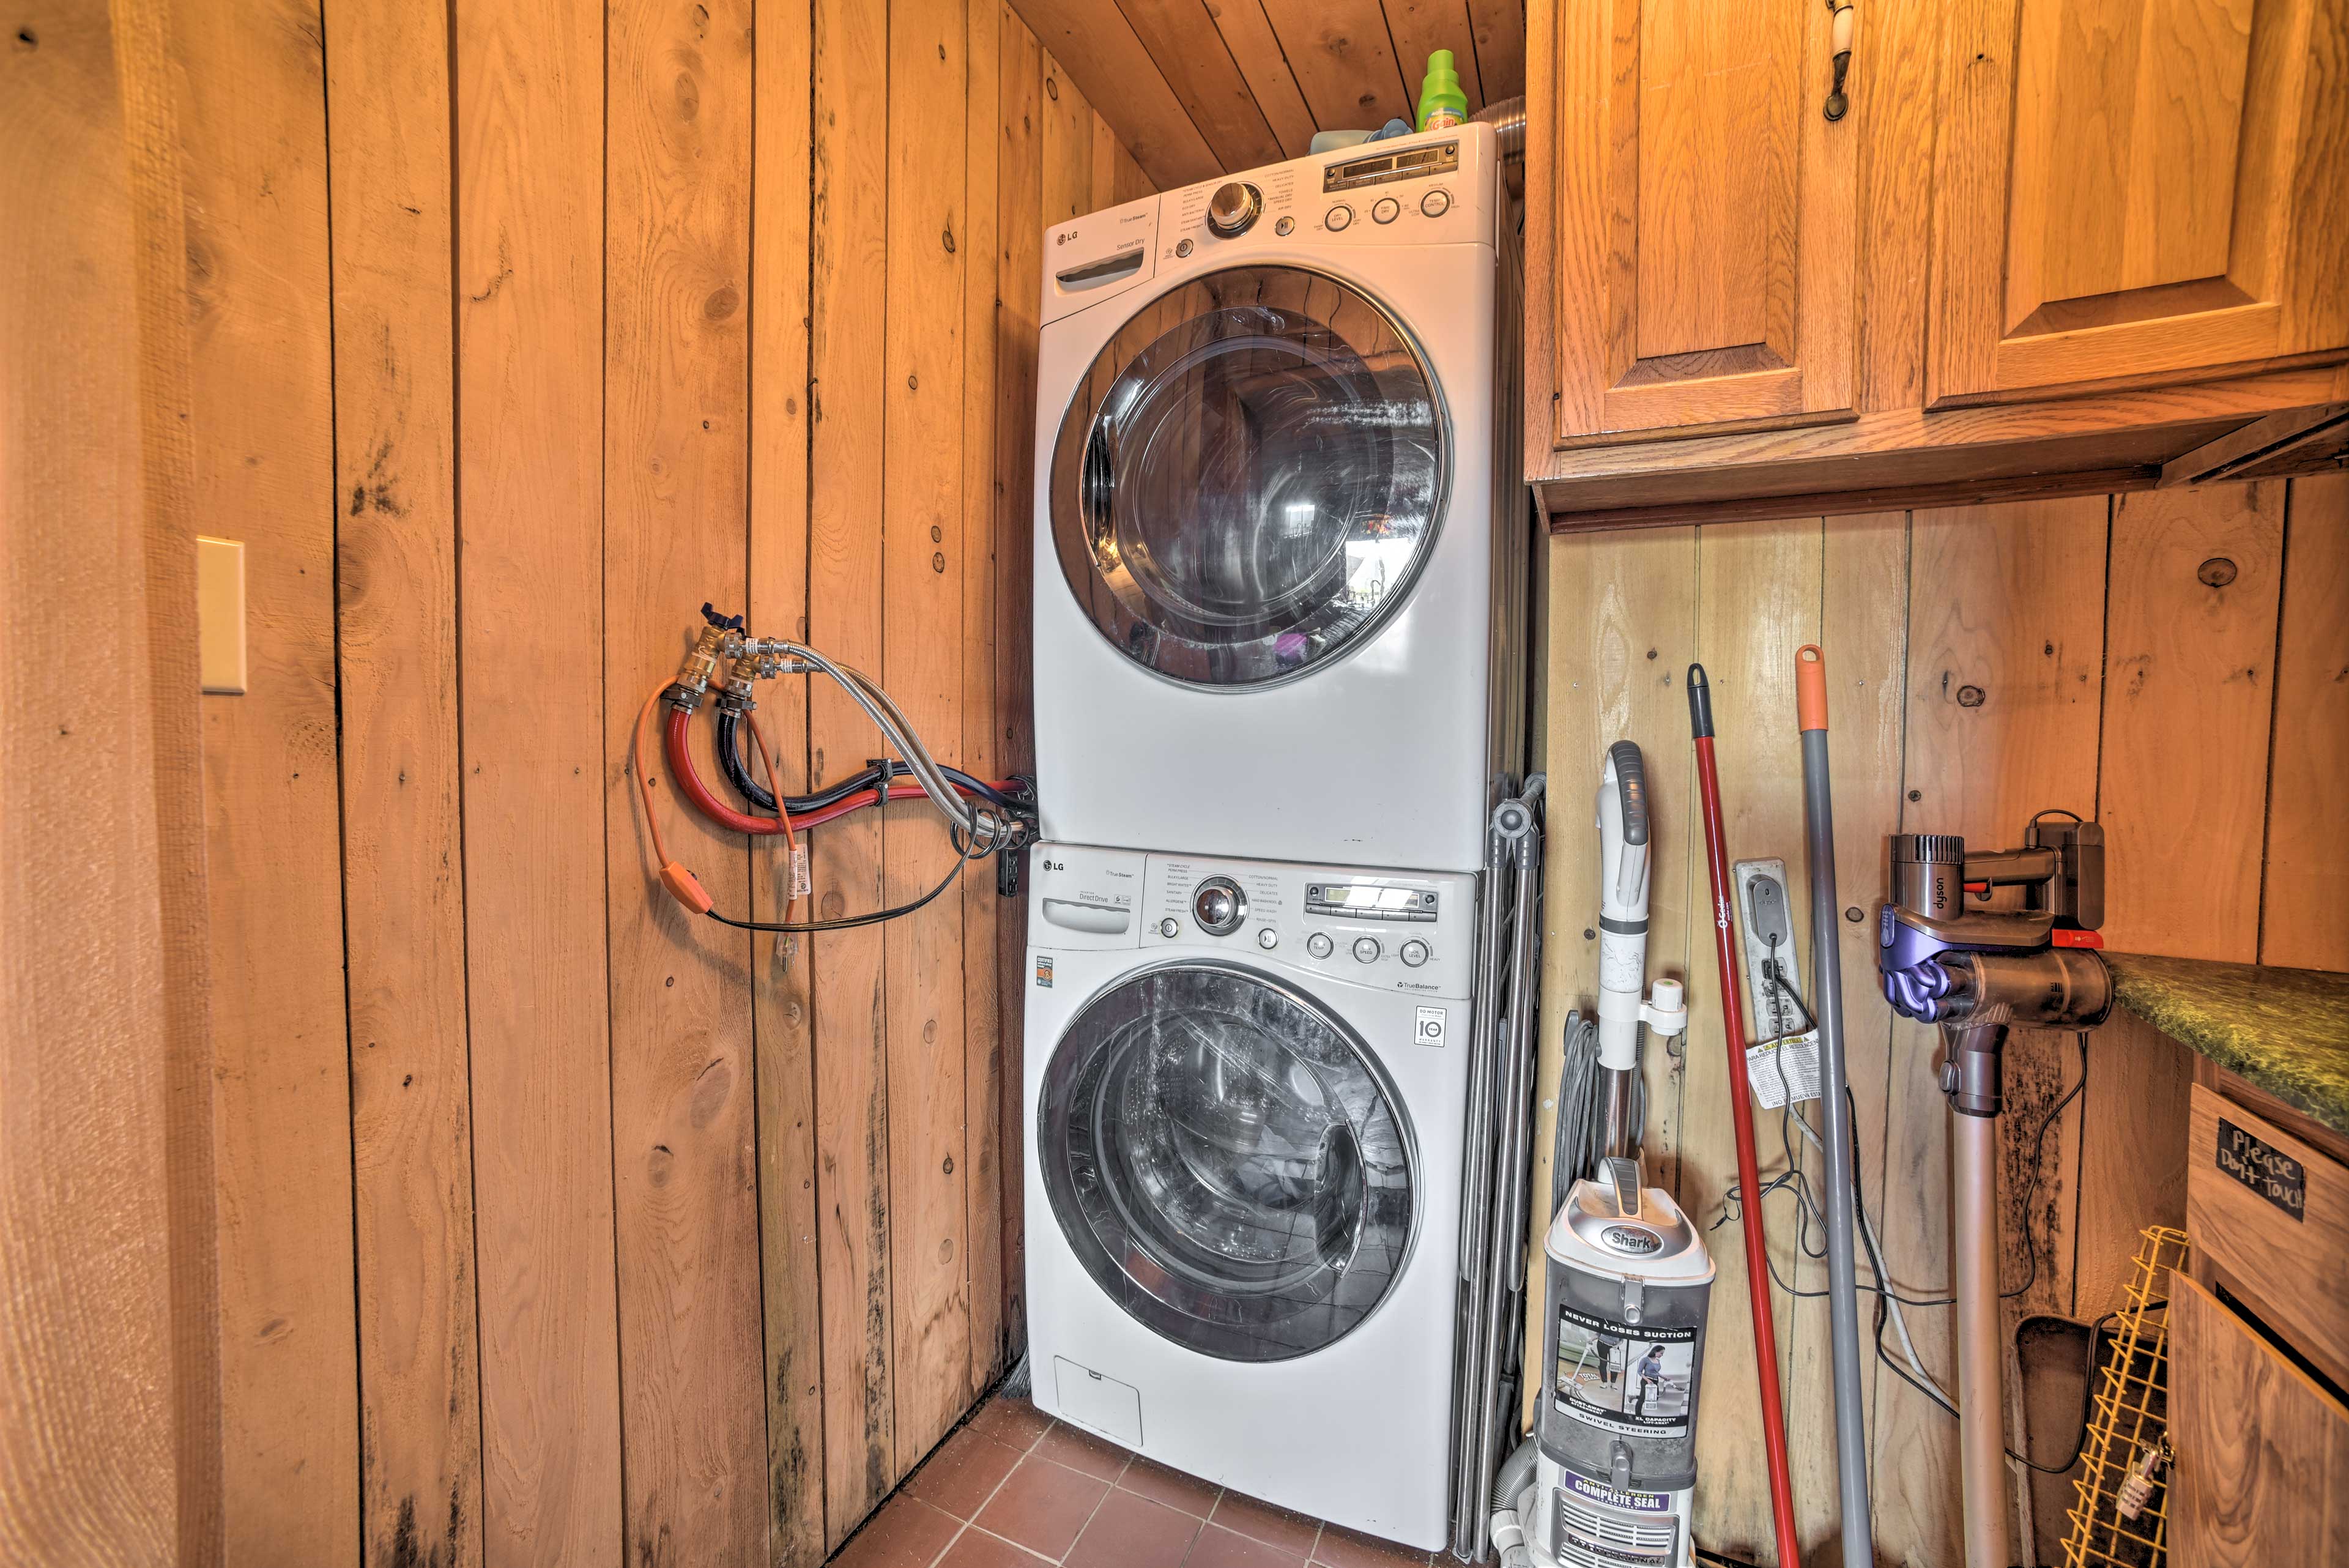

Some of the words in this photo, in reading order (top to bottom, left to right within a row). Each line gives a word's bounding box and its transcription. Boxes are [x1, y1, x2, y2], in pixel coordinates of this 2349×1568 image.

[1431, 117, 1455, 130] Gain
[1067, 231, 1078, 242] LG
[1116, 241, 1134, 250] Sensor
[1135, 237, 1145, 246] Dry
[1933, 877, 1947, 909] dyson
[1419, 1020, 1442, 1038] 10
[1783, 1092, 1810, 1103] RMUEVA
[2232, 1131, 2296, 1180] Please
[1612, 1232, 1650, 1249] Shark
[1565, 1310, 1600, 1328] NEVER
[1603, 1323, 1640, 1336] LOSES
[1579, 1413, 1614, 1429] SWIVEL
[1618, 1425, 1666, 1435] STEERING
[1575, 1480, 1631, 1506] COMPLETE
[1634, 1497, 1660, 1509] SEAL
